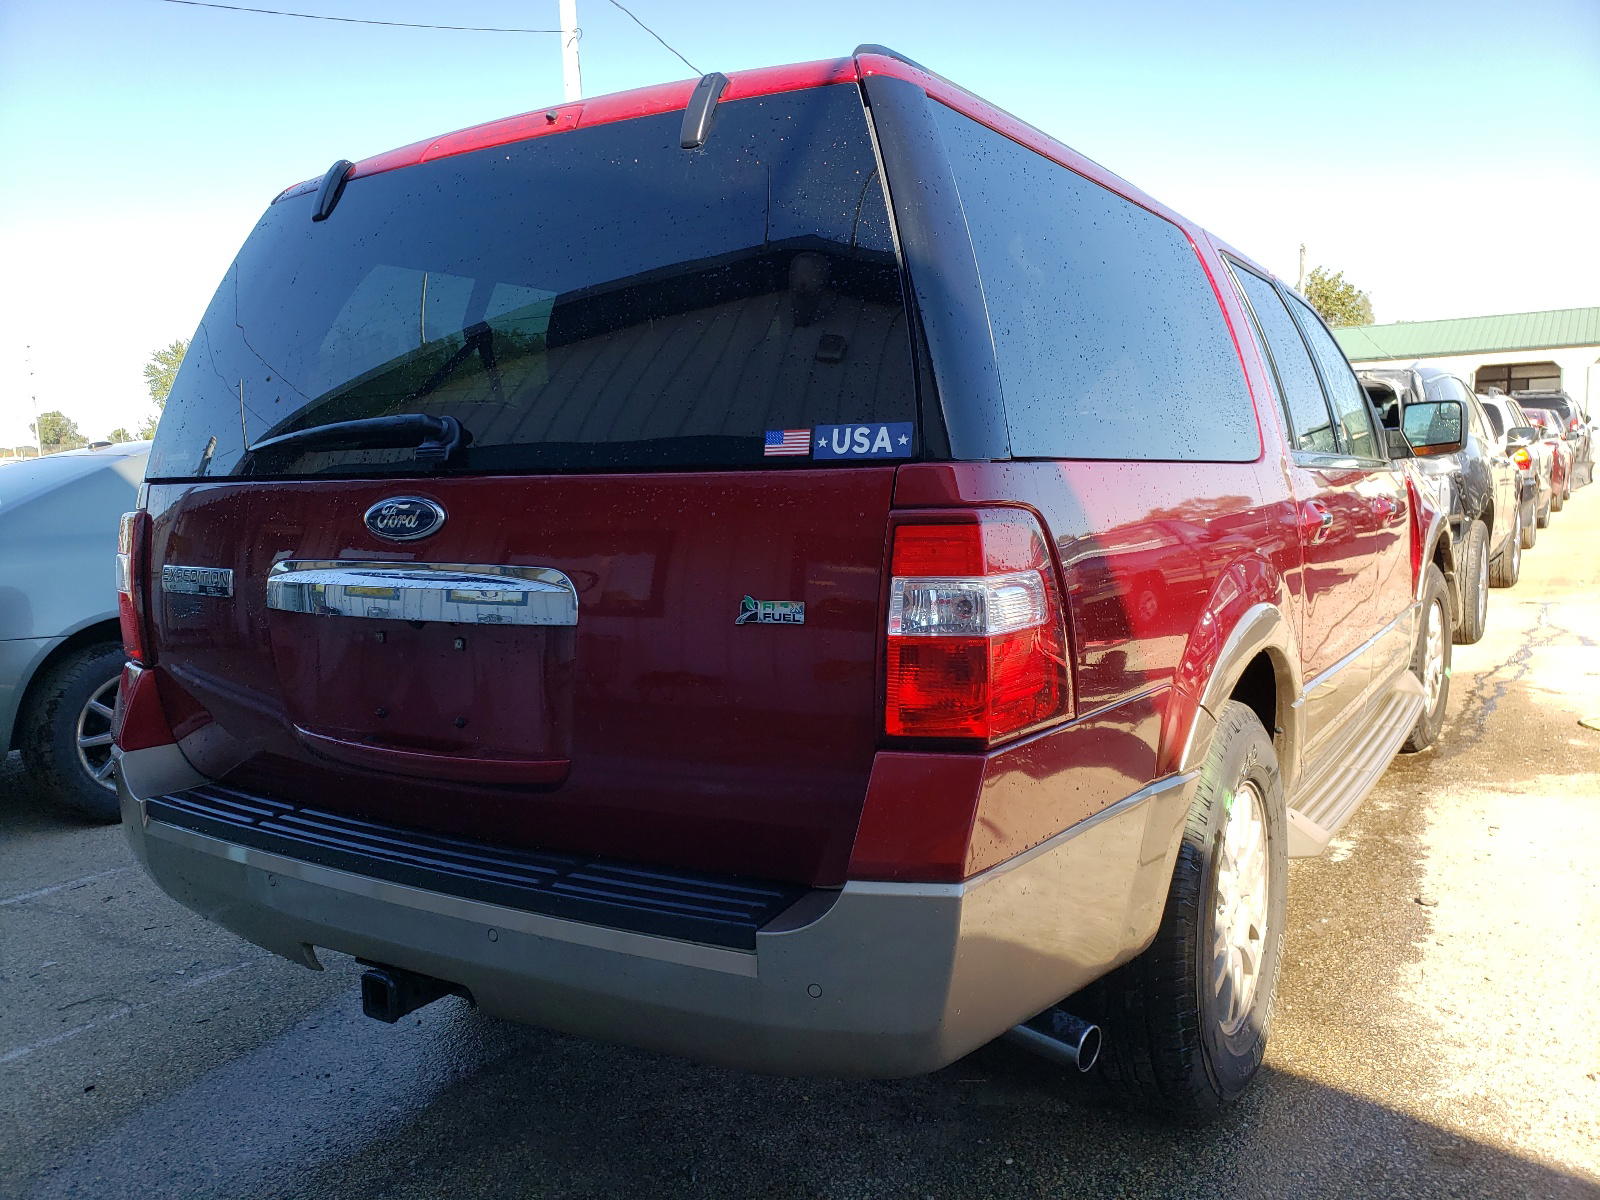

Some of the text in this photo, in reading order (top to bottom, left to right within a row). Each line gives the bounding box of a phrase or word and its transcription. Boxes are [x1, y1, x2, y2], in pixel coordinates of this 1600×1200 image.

[832, 426, 893, 455] USA
[377, 503, 421, 529] Ford
[162, 567, 231, 586] EXPEDITION
[763, 612, 801, 623] FUEL
